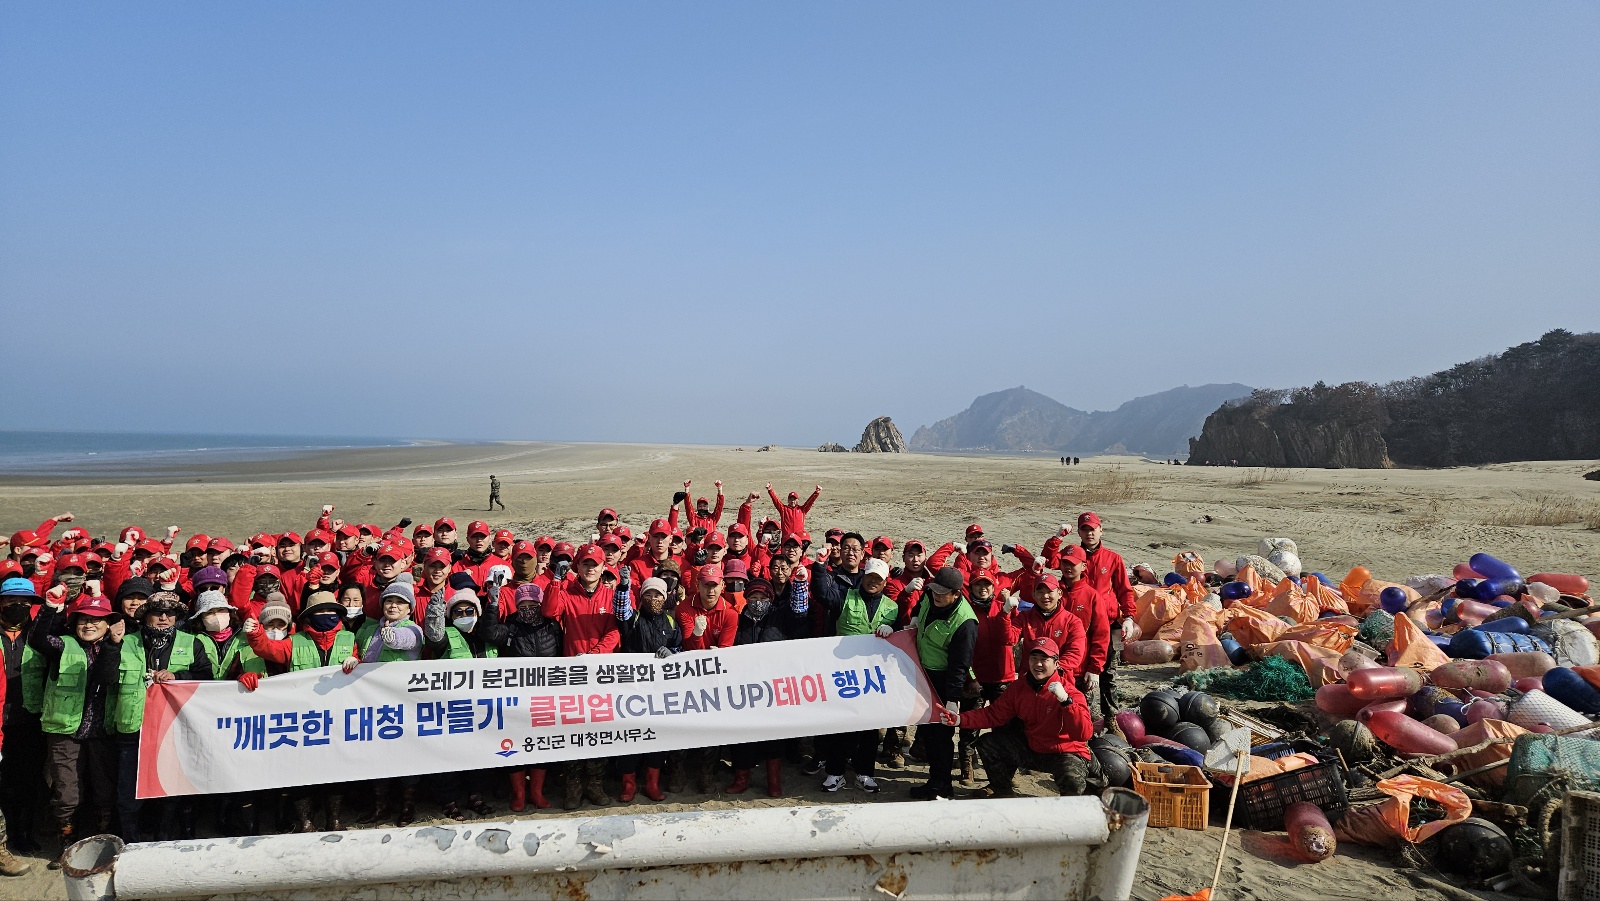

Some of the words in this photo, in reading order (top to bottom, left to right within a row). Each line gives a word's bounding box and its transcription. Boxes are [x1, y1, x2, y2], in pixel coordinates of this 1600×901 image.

[407, 669, 474, 693] 쓰레기
[482, 665, 588, 689] 분리배출을
[596, 663, 655, 684] 생활화
[661, 656, 727, 681] 합시다.
[217, 709, 333, 750] "깨끗한
[344, 703, 404, 742] 대청
[416, 696, 518, 737] 만들기"
[530, 686, 721, 727] 클린업(CLEAN
[726, 673, 827, 711] UP)데이
[831, 665, 887, 698] 행사
[521, 734, 566, 752] 옹진군
[570, 727, 657, 747] 대청면사무소
